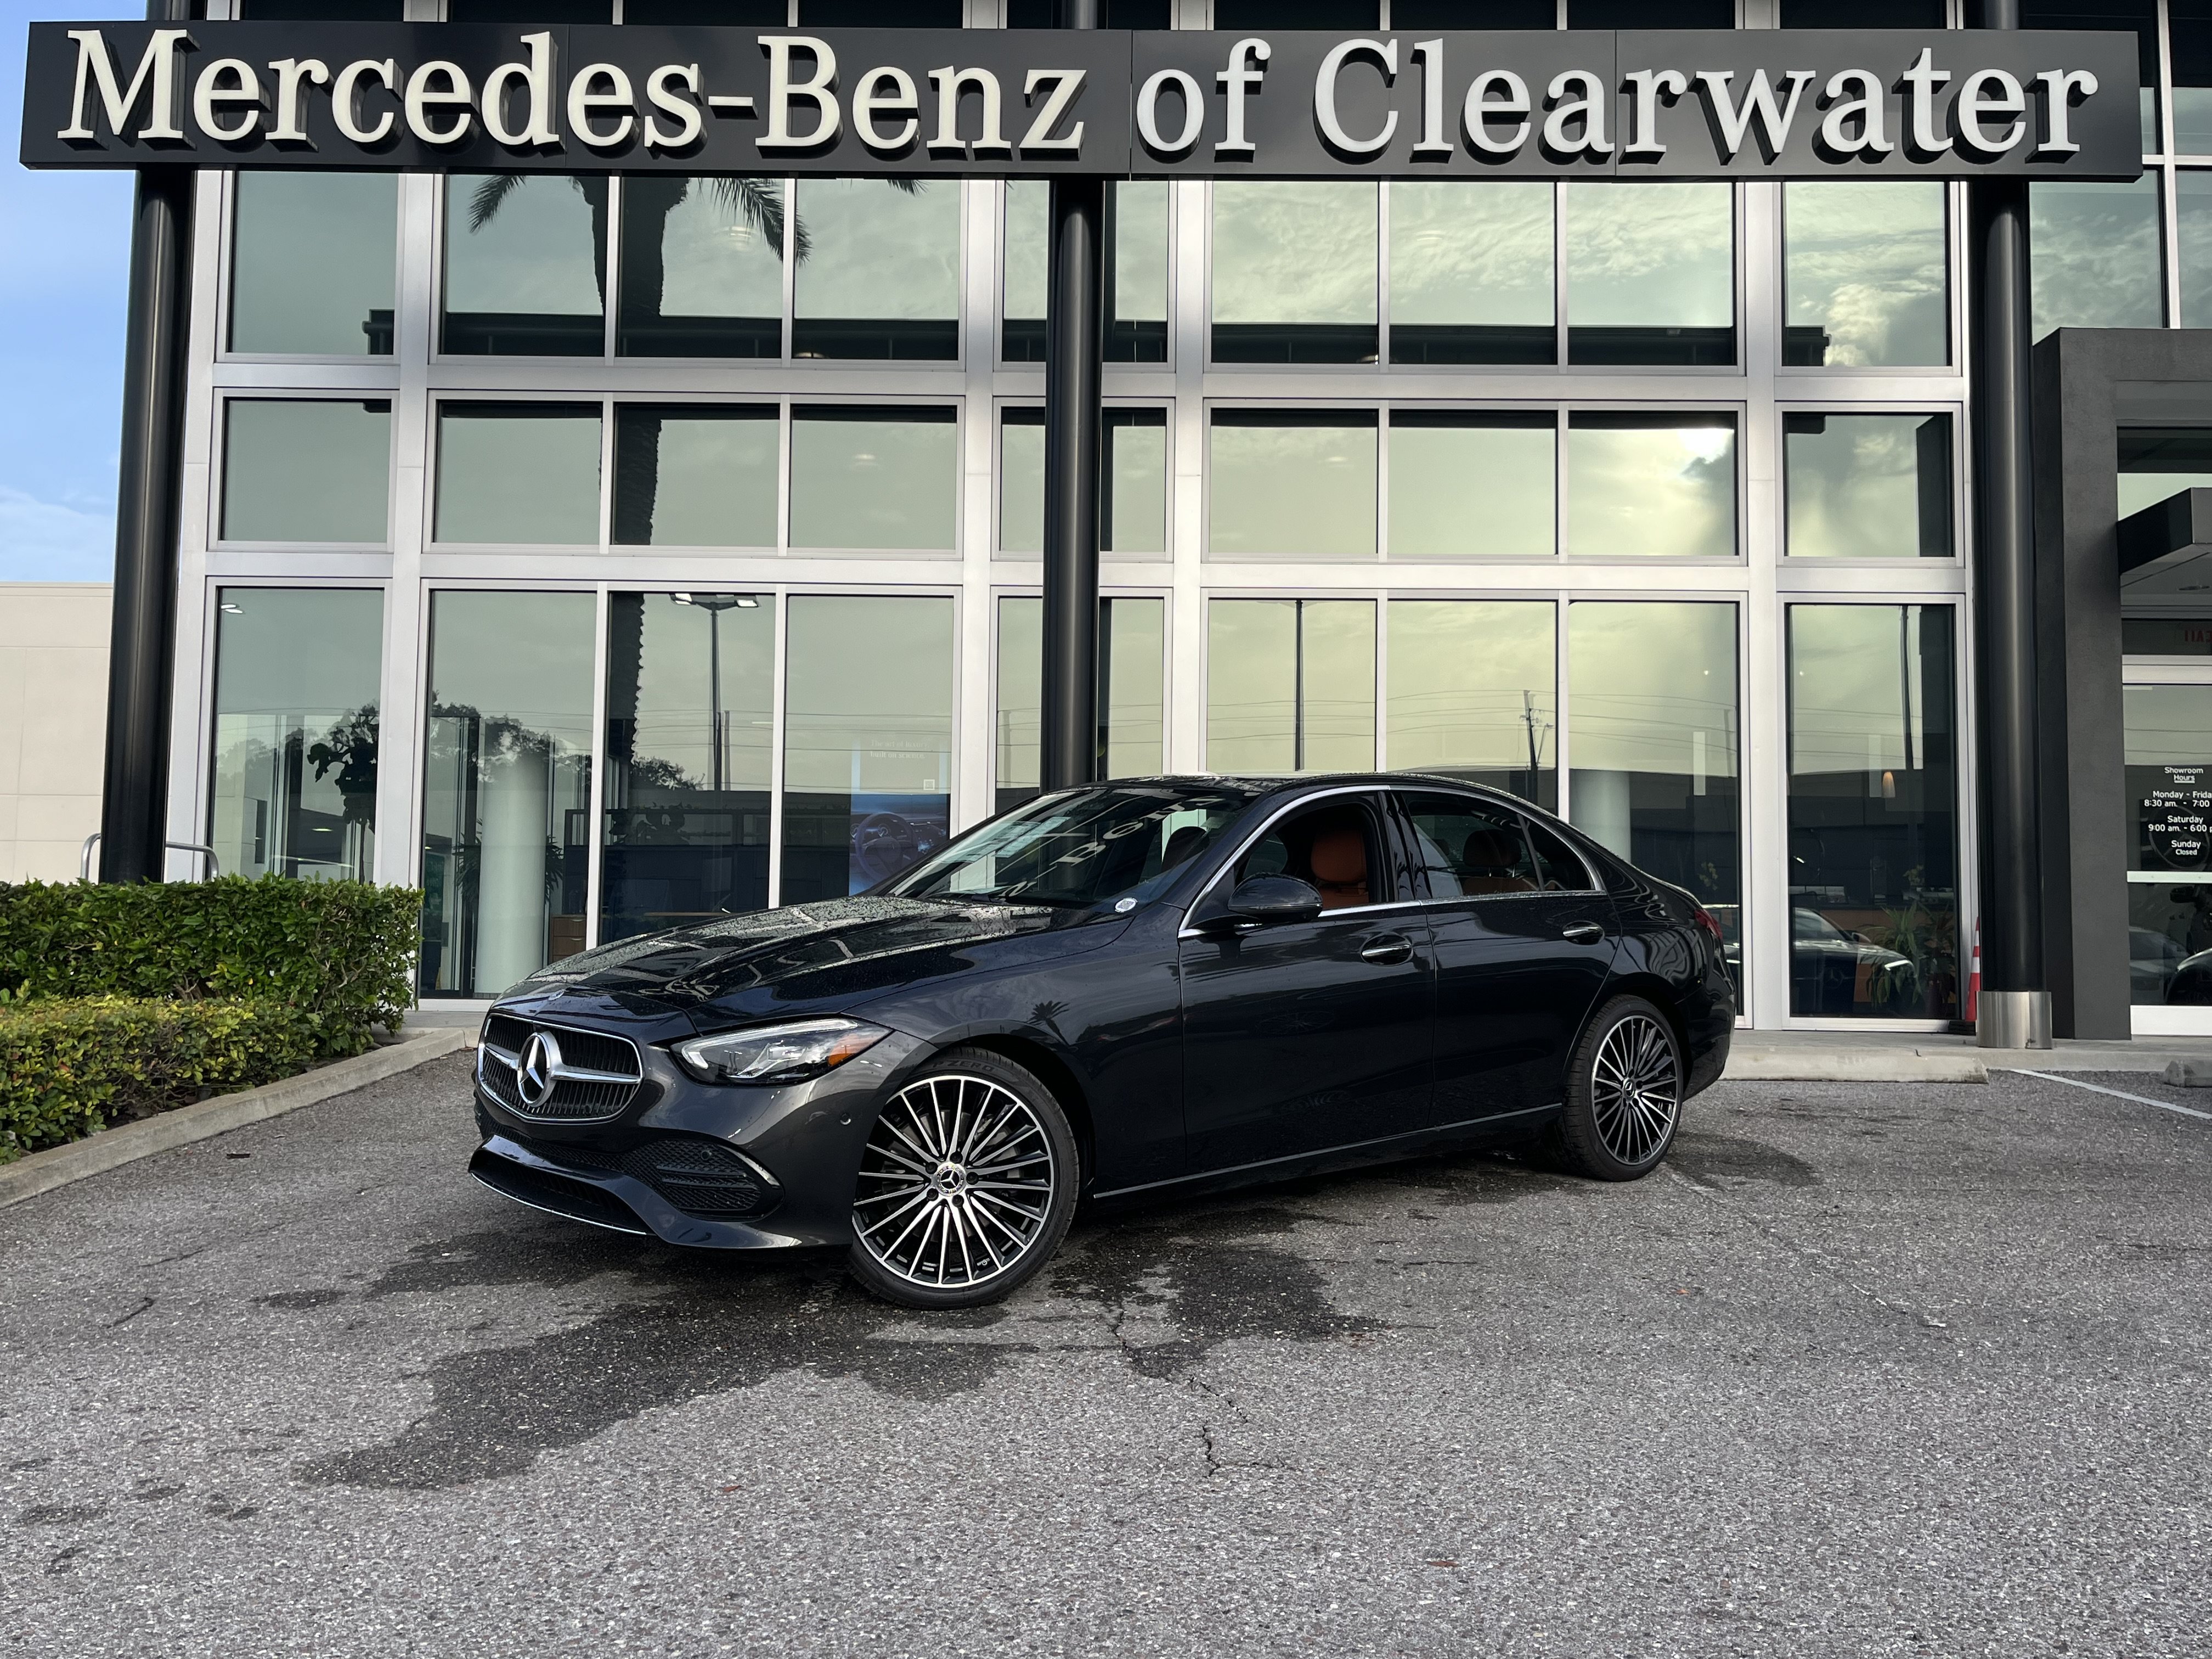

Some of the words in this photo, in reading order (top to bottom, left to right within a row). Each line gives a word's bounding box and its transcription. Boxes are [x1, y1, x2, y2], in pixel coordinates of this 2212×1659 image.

[57, 29, 1087, 151] Mercedes-Benz
[1136, 38, 1271, 152] of
[1314, 38, 2098, 153] Clearwater
[2153, 791, 2183, 799] Monday
[2167, 815, 2203, 824] Saturday
[2171, 840, 2201, 849] Sunday
[947, 1060, 994, 1072] ZERO
